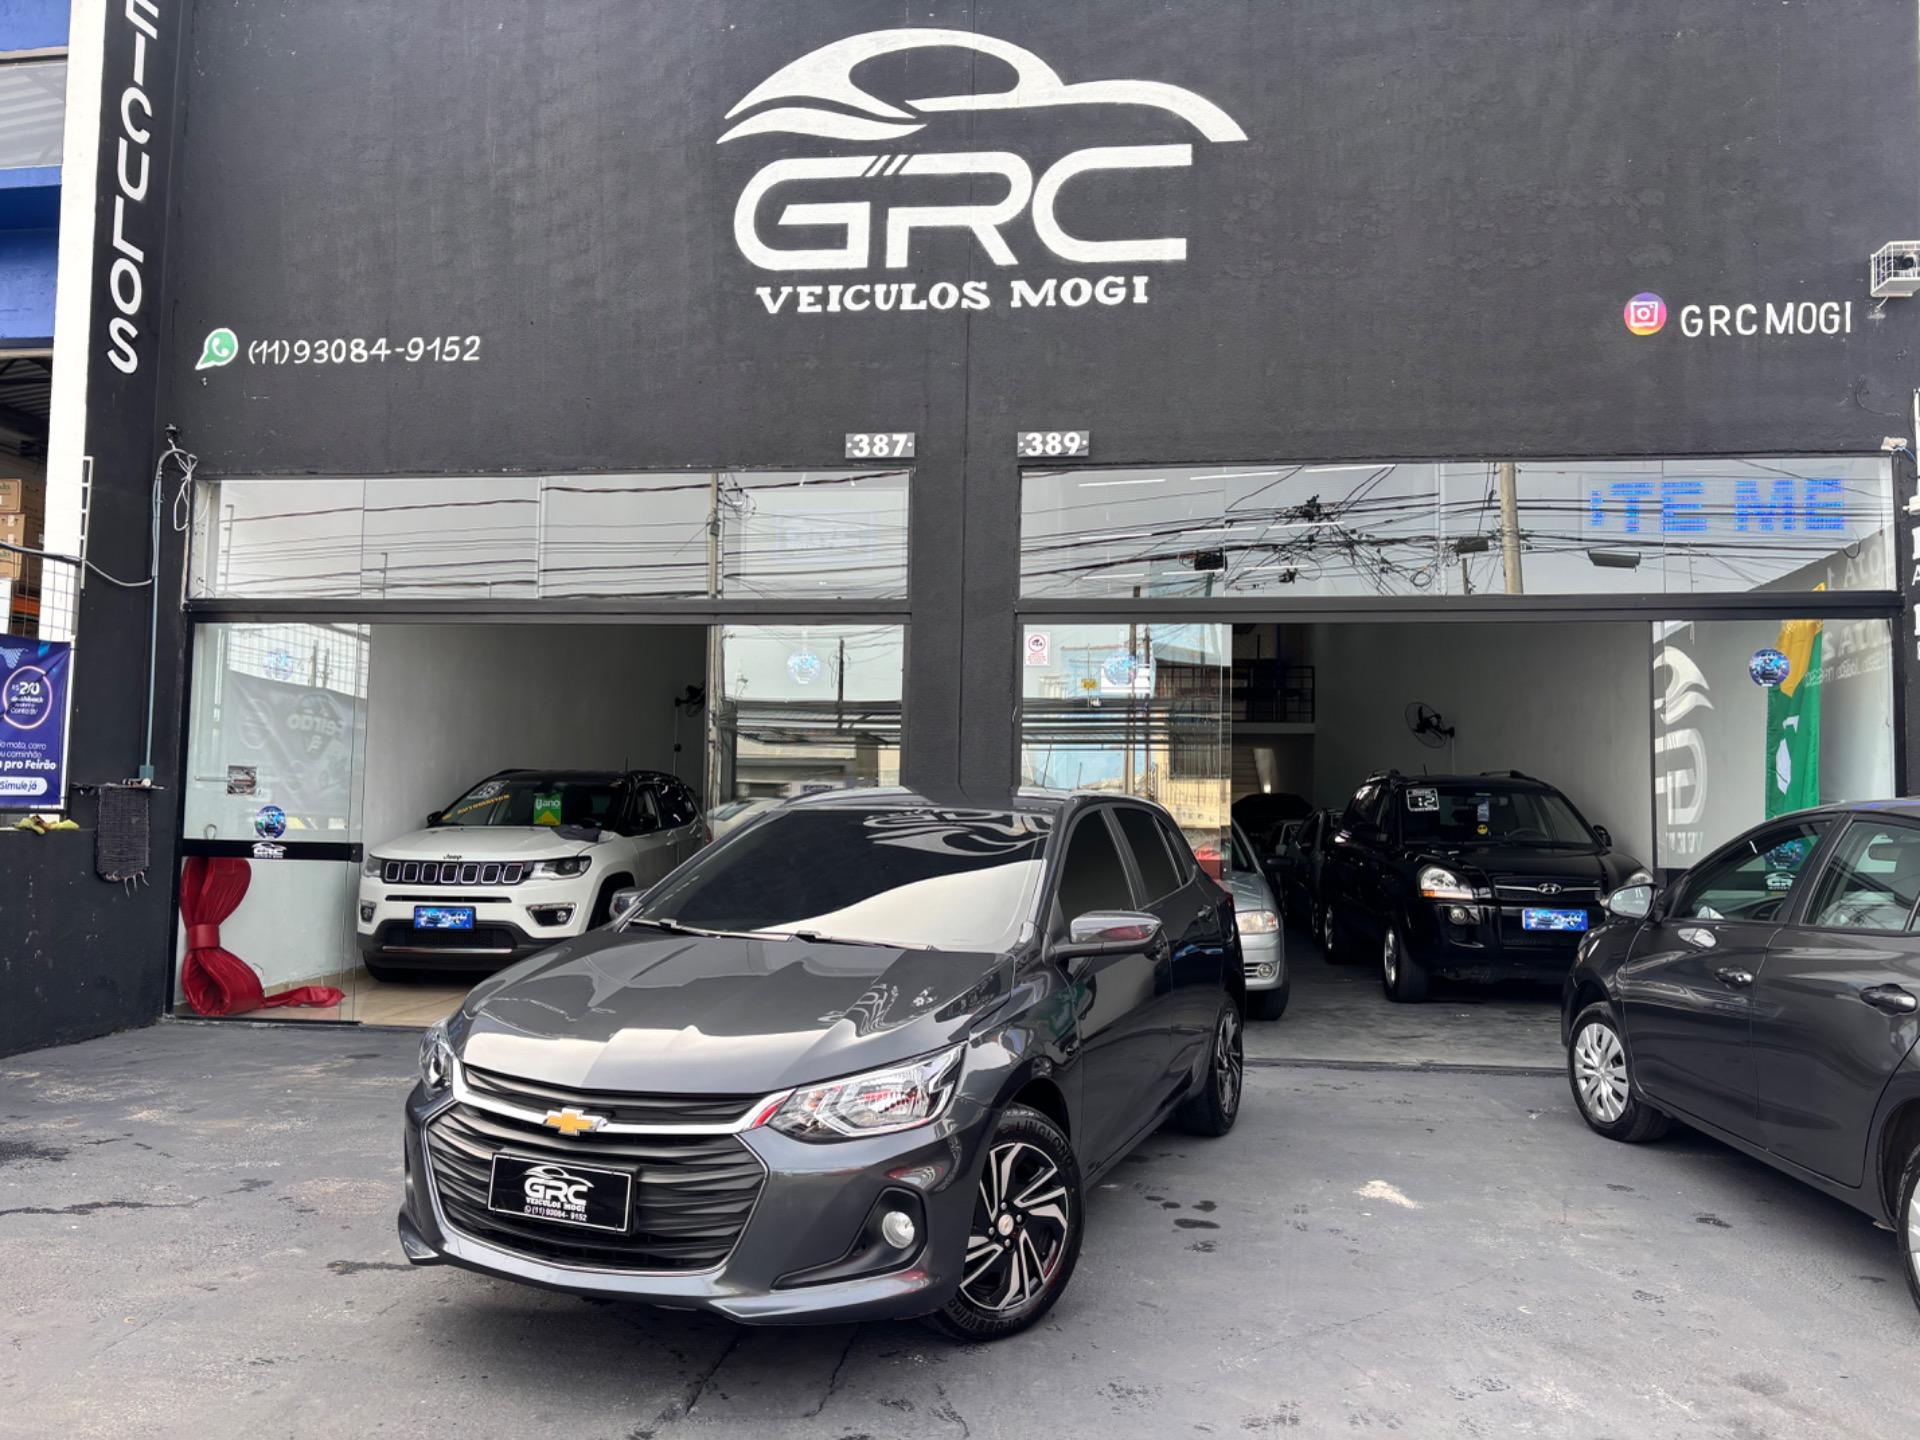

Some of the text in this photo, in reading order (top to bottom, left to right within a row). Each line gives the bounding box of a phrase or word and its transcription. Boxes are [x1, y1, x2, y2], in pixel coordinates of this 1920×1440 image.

[733, 143, 1193, 271] GRC
[756, 275, 1149, 314] VEICULOS MOGI
[248, 336, 481, 364] (11)93084-9152
[852, 433, 907, 457] 387
[1024, 432, 1082, 456] 389
[28, 742, 47, 750] carro
[4, 761, 23, 771] pro
[25, 759, 56, 770] Feirão
[0, 781, 27, 790] Simule
[524, 1177, 588, 1206] GRC
